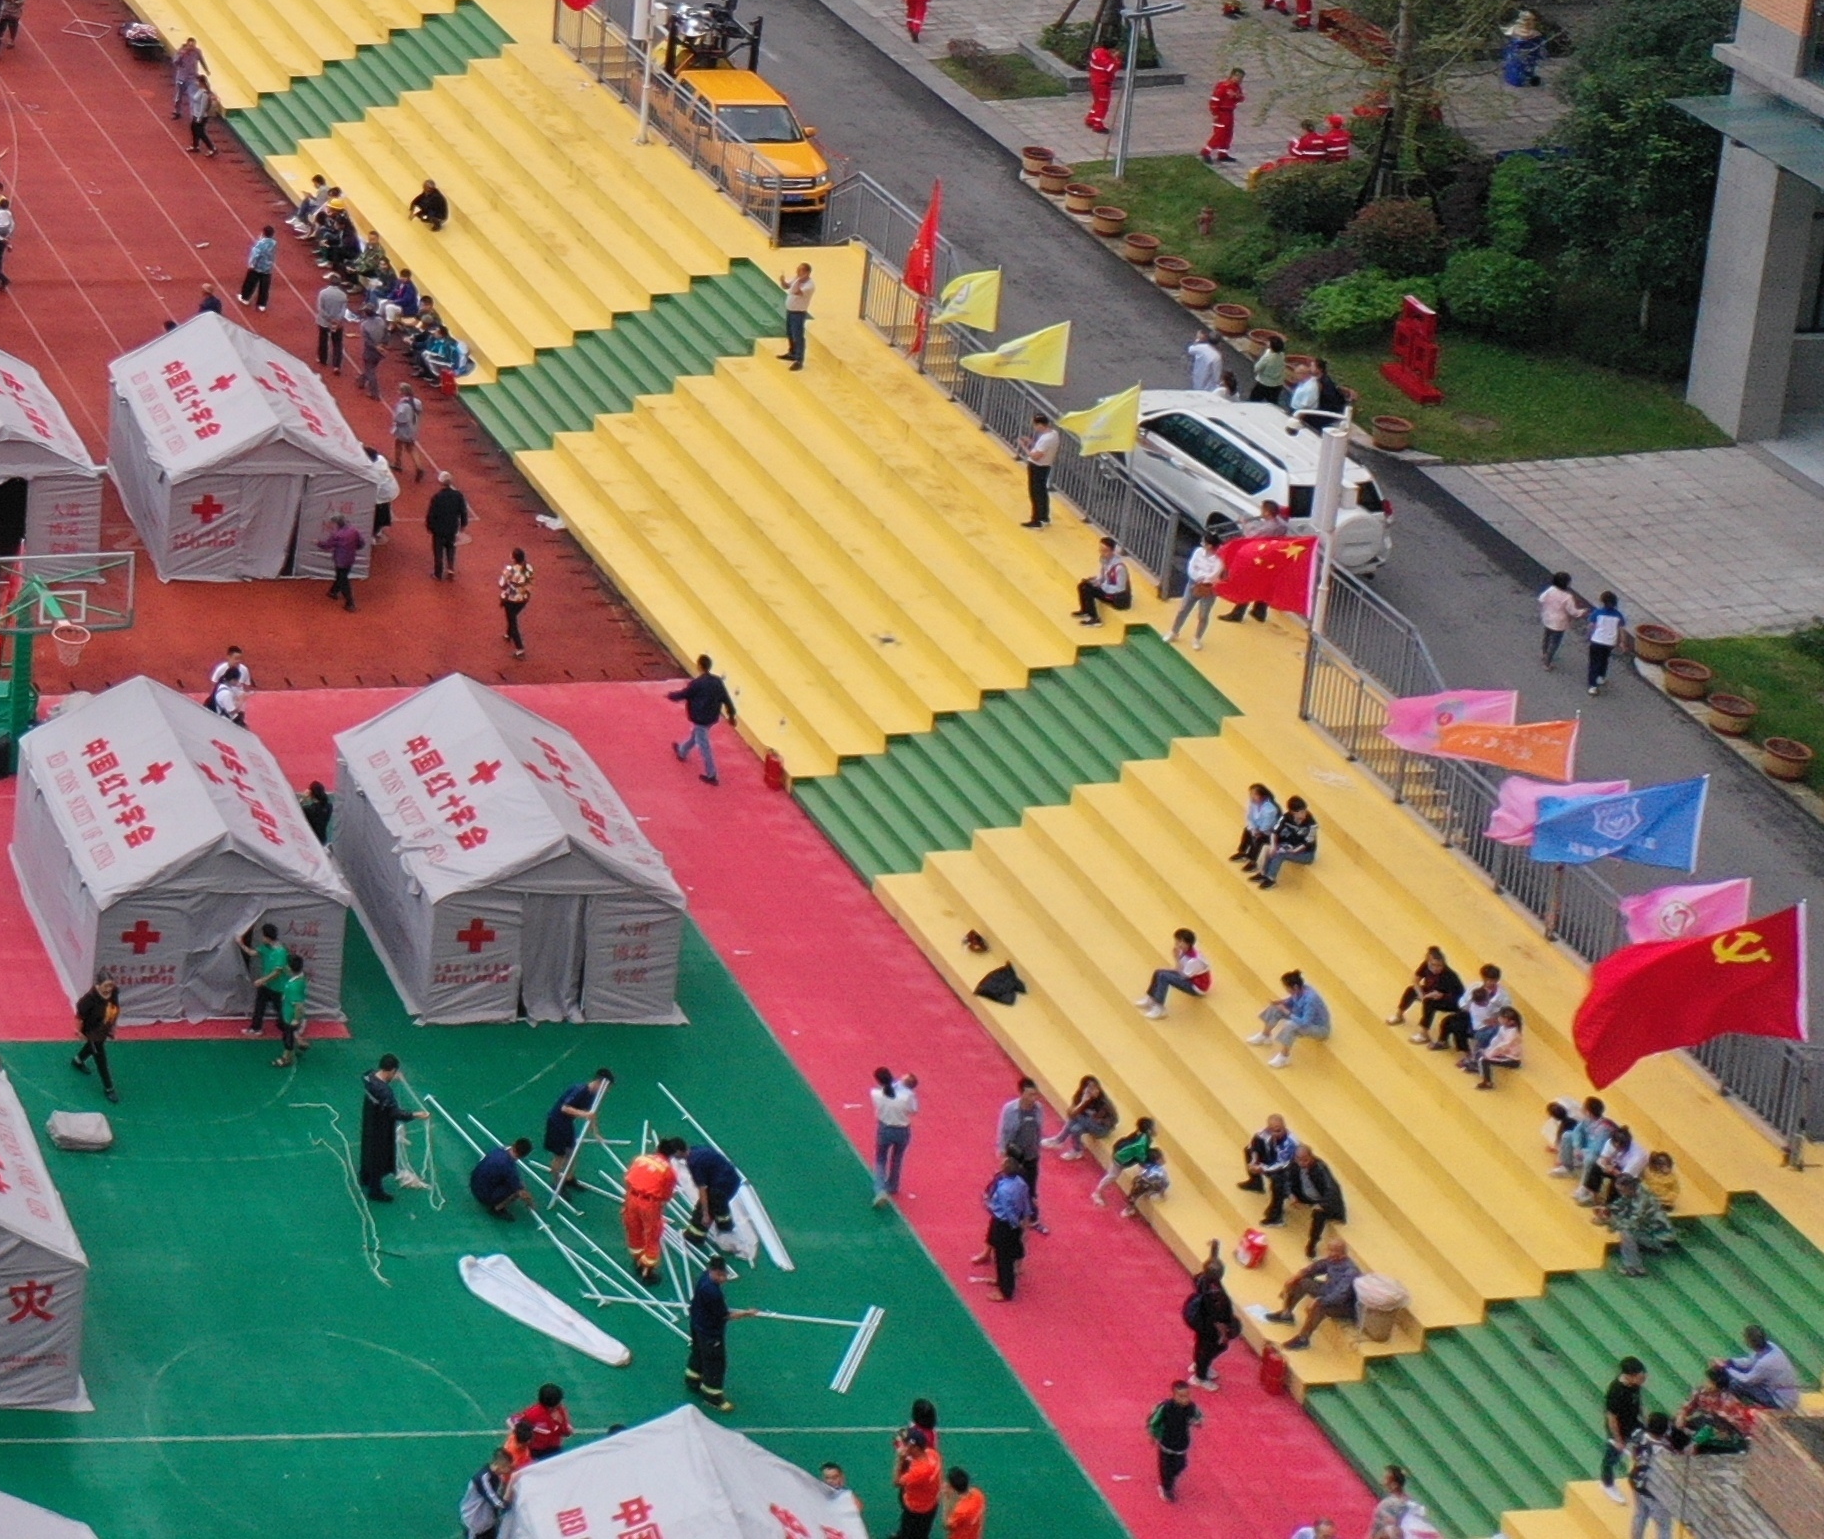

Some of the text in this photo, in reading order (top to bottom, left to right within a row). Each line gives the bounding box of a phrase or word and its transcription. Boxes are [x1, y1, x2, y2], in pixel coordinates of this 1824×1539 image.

[161, 359, 222, 441] 中国红十字会
[83, 737, 157, 848] 中国红十字会
[406, 734, 490, 850] 中国红十字会
[9, 1281, 54, 1323] 灾
